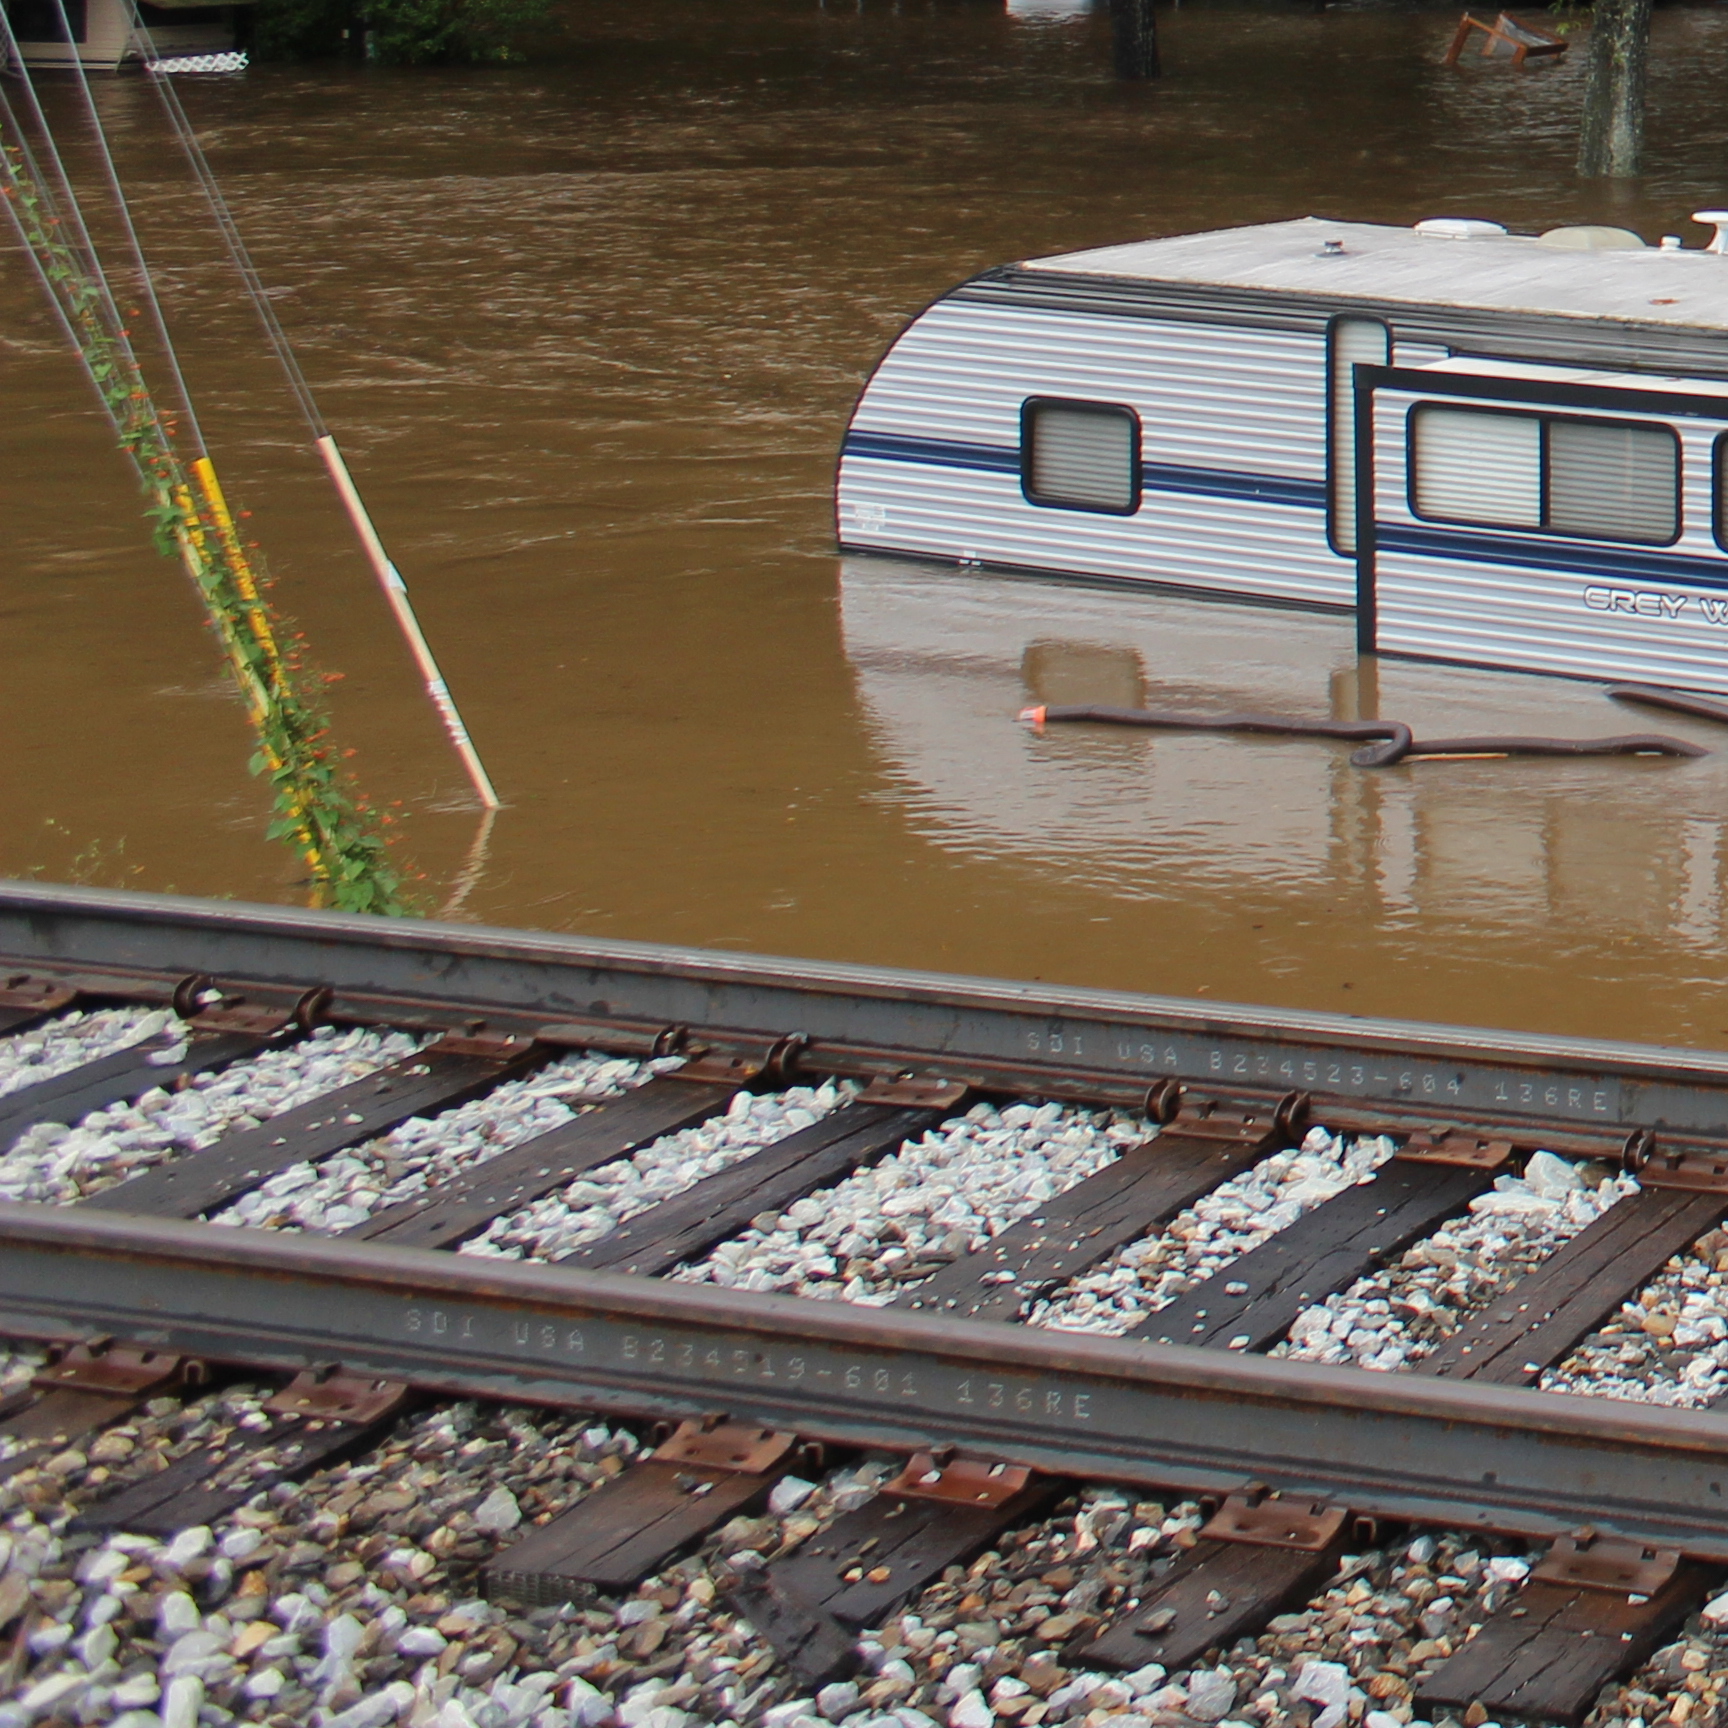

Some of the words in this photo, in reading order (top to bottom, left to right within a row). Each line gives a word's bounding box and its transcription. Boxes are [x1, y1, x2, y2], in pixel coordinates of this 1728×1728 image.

[1583, 584, 1688, 618] GREY
[1117, 1042, 1178, 1067] USA
[1494, 1080, 1608, 1112] 136RE
[406, 1307, 475, 1338] SDI
[514, 1321, 585, 1352] USA
[956, 1378, 1091, 1420] 136RE
